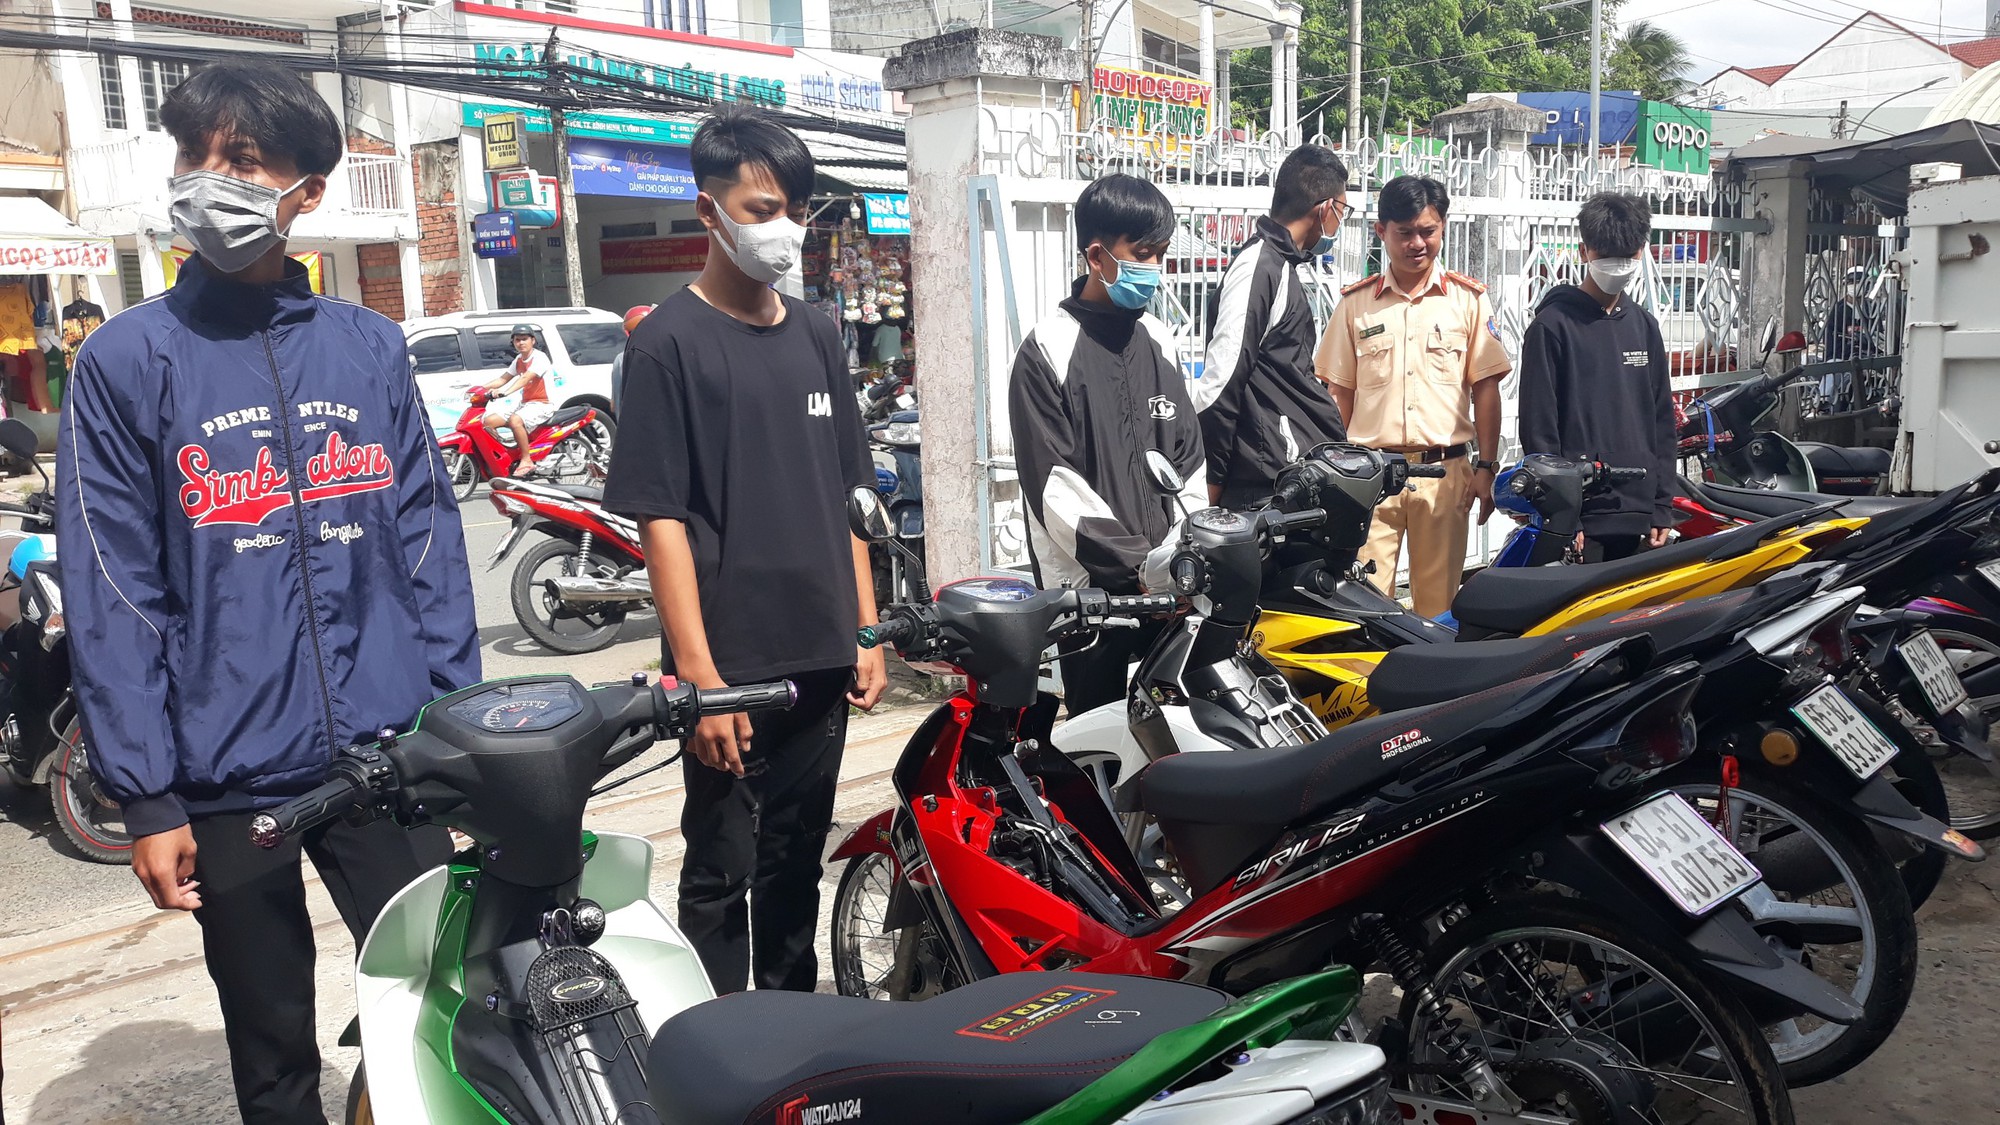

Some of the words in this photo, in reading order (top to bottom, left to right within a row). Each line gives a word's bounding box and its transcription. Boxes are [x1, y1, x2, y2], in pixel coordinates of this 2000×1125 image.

[652, 62, 716, 102] KIÊN
[720, 73, 787, 106] LONG
[801, 70, 836, 108] NHÀ
[839, 75, 882, 112] SÁCH
[1094, 67, 1212, 104] HOTOCOPY
[1143, 99, 1206, 137] TRUNG
[490, 143, 517, 152] WESTERN
[498, 150, 517, 158] UNION
[628, 182, 645, 192] DÀNH
[645, 184, 658, 193] CHO
[670, 185, 685, 195] SHOP
[52, 242, 108, 267] XUÂN
[201, 406, 272, 438] PREME
[297, 401, 360, 423] NTLES
[303, 421, 327, 433] ENCE
[1318, 705, 1355, 726] YAMAHA
[1802, 691, 1856, 737] 65-B2
[1381, 735, 1432, 761] PROFESSIONAL
[1832, 721, 1892, 775] 393.44
[1312, 832, 1388, 871] STYLISH
[1401, 790, 1484, 831] EDITION
[1619, 800, 1702, 860] 64-G1
[1231, 812, 1367, 891] SIRIUS
[1657, 838, 1748, 906] 407.55
